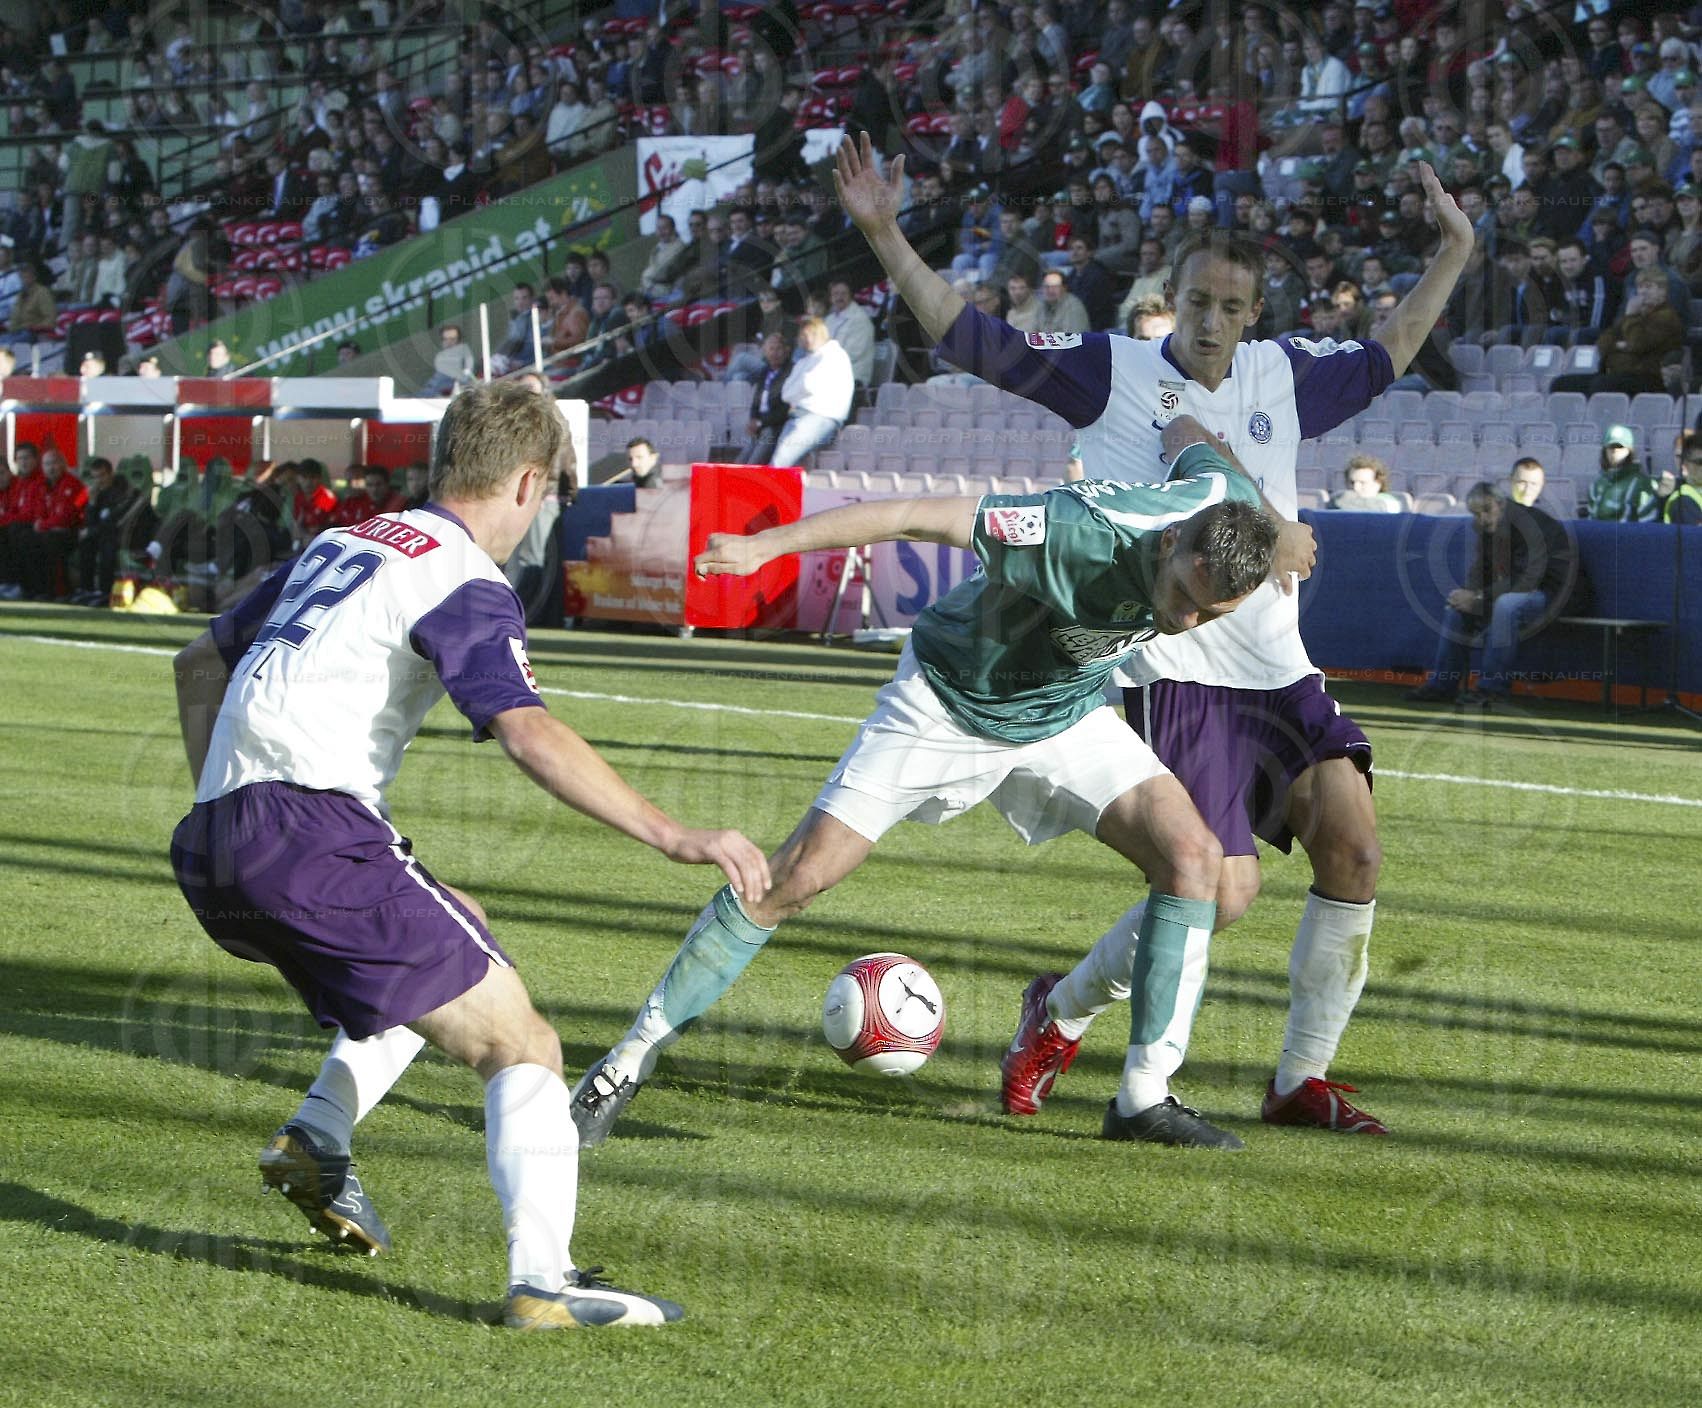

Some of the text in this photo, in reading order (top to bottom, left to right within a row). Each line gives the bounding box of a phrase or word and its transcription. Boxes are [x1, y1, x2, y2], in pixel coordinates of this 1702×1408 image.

[256, 217, 556, 370] www.skrapid.at
[347, 518, 429, 554] URIER
[252, 540, 387, 650] 22
